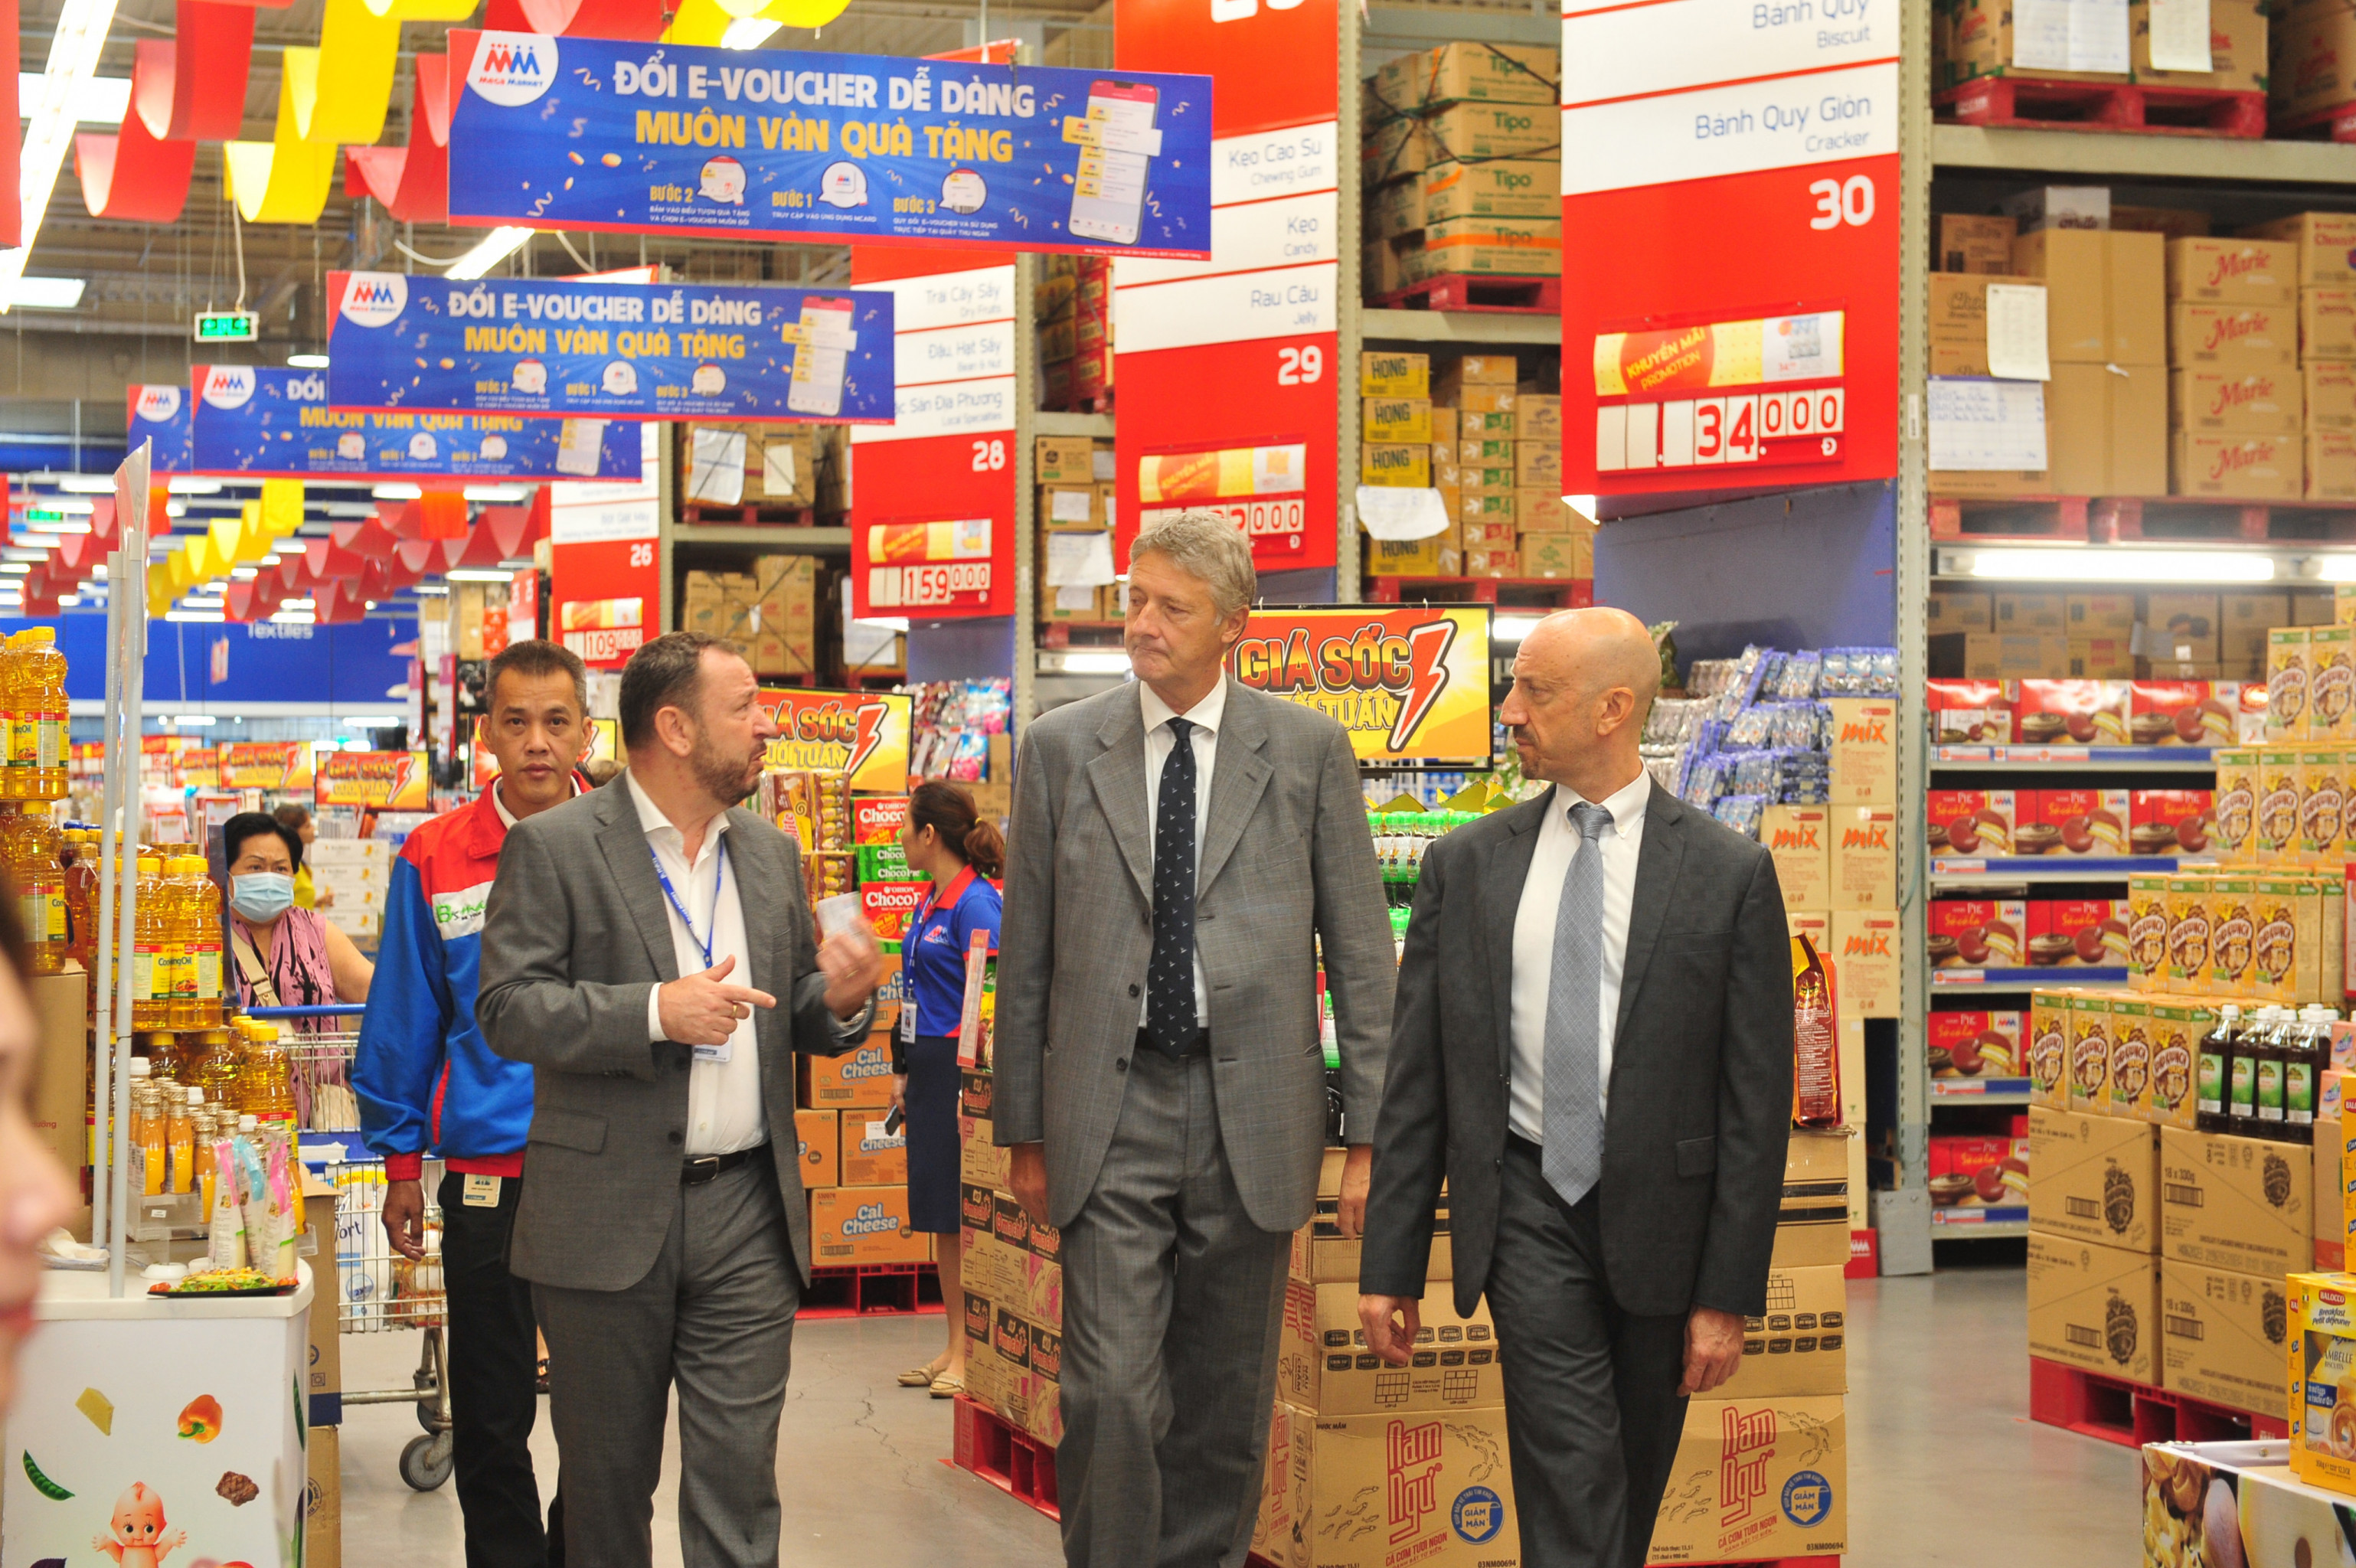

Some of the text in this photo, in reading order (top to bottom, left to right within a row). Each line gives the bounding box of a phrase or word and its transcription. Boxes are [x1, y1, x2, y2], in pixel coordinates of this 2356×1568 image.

[1753, 0, 1869, 29] Bánh Quy
[1817, 26, 1871, 48] Biscuit
[614, 50, 1035, 118] ĐỔI E-VOUCHER DỄ DÀNG
[1493, 112, 1533, 133] Tipo
[1694, 95, 1871, 140] Bánh Quy Giòn
[636, 106, 1013, 168] MUÔN VÀN QUÀ TẶNG
[1805, 131, 1871, 153] Cracker
[1265, 143, 1295, 164] Cao
[1301, 137, 1322, 158] Su
[1251, 165, 1322, 187] Chewing Gum
[1493, 169, 1533, 191] Tipo
[650, 183, 694, 203] BƯỚC 2
[772, 189, 812, 207] BƯỚC 1
[1809, 175, 1875, 230] 30
[894, 195, 935, 214] BƯỚC 3
[1283, 243, 1319, 257] Candy
[2208, 248, 2272, 286] Marie
[448, 283, 762, 326] ĐỔI E-VOUCHER DỄ DÀNG
[1251, 289, 1281, 308] Rau
[1293, 311, 1319, 326] Jelly
[2205, 311, 2270, 351] Marie
[464, 323, 745, 364] MUÔN VÀN QUÀ TẶNG
[1278, 345, 1322, 386] 29
[1640, 350, 1702, 391] PROMOTION
[286, 373, 325, 400] ĐỔI
[2210, 377, 2275, 415] Marie
[972, 439, 1005, 472] 28
[2210, 442, 2275, 481] Marie
[247, 619, 314, 640] Textiles
[1240, 624, 1411, 688] GIÁ SỐC
[760, 701, 857, 742] IÁ SỐC
[328, 755, 395, 780] GIÁ SỐC
[866, 891, 921, 907] ChocoP
[856, 1047, 883, 1065] Cal
[841, 1062, 894, 1080] Cheese
[859, 1136, 906, 1152] Cheese
[857, 1201, 884, 1220] Cal
[841, 1215, 898, 1235] Cheese
[2320, 1292, 2345, 1303] BALOCCO
[2312, 1317, 2351, 1327] Petit déjeuner
[2318, 1308, 2346, 1317] Breakfast
[2324, 1350, 2353, 1364] AMBELLE
[1722, 1406, 1776, 1459] Nam
[1794, 1491, 1815, 1501] GIẢM
[1796, 1501, 1814, 1512] MẶN
[1465, 1506, 1486, 1517] GIẢM
[1466, 1517, 1485, 1529] MẶN
[1718, 1514, 1777, 1549] CÁ CƠM TƯƠI NGON
[1386, 1531, 1448, 1567] CÁ CƠM TƯƠI NGON
[1806, 1542, 1844, 1551] 03NM00694
[1478, 1559, 1517, 1568] 03NM00694
